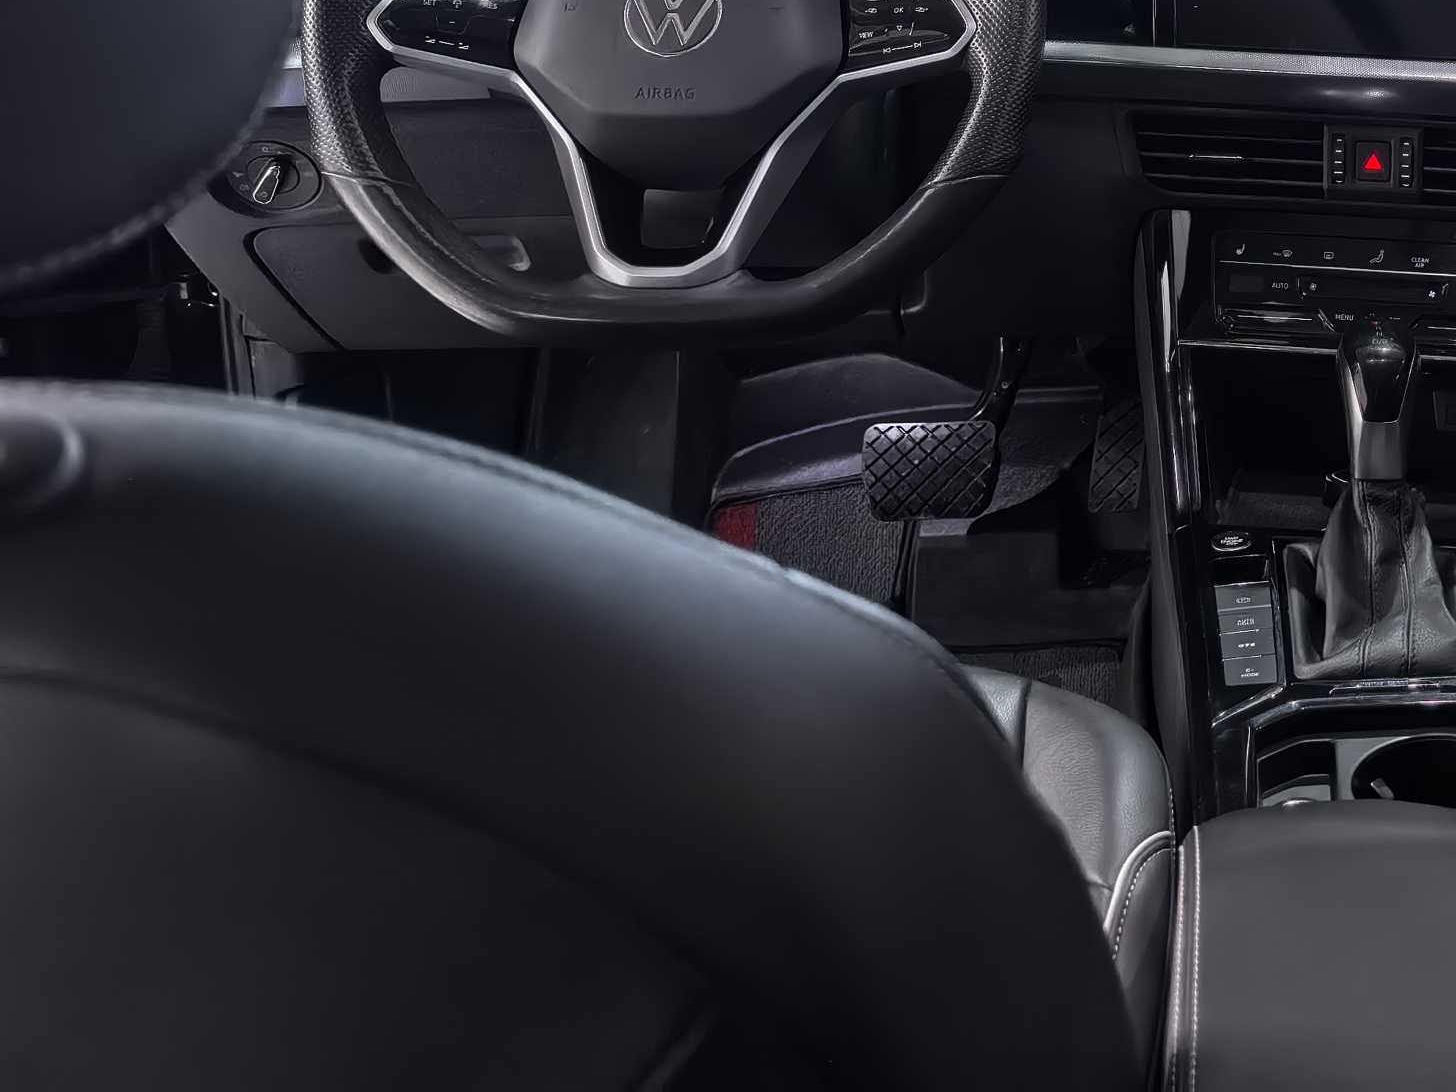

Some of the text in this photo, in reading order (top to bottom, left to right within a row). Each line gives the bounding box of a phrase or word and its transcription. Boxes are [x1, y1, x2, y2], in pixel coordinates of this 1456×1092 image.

[859, 31, 873, 39] VIEW
[634, 87, 696, 101] AIRBAG
[1411, 256, 1429, 264] CLEAN
[1271, 282, 1289, 290] AUTO
[1335, 313, 1354, 321] MENU
